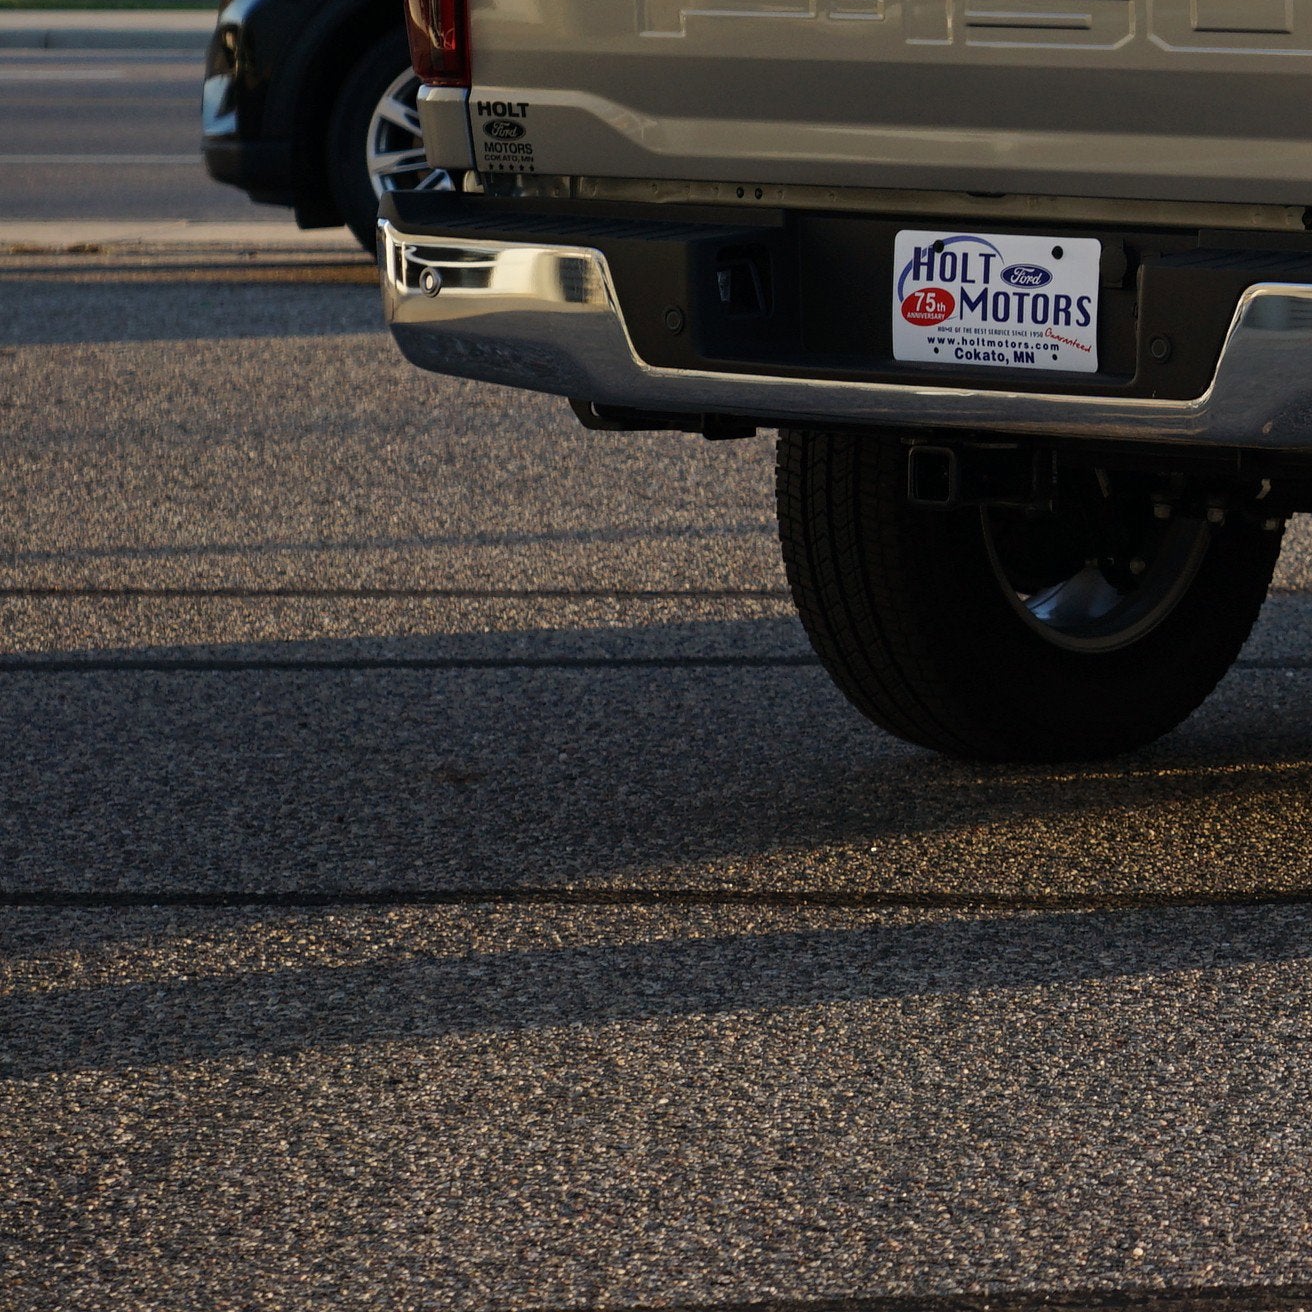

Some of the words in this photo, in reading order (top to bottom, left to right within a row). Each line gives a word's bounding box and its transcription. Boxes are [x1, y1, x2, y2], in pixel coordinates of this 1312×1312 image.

[477, 101, 529, 118] HOLT
[484, 142, 533, 155] MOTORS
[912, 246, 997, 285] HOLT
[914, 291, 946, 313] 75th
[960, 286, 1092, 328] MOTORS
[906, 312, 946, 321] ANNIVERSARY
[988, 328, 1010, 336] SERVICE
[1012, 329, 1028, 337] SINCE
[1029, 330, 1044, 338] 1950
[1045, 327, 1092, 354] Guaranteed
[927, 336, 1060, 351] www.holtmotors.com
[954, 347, 1010, 365] Cokato,
[1014, 350, 1036, 364] MN
